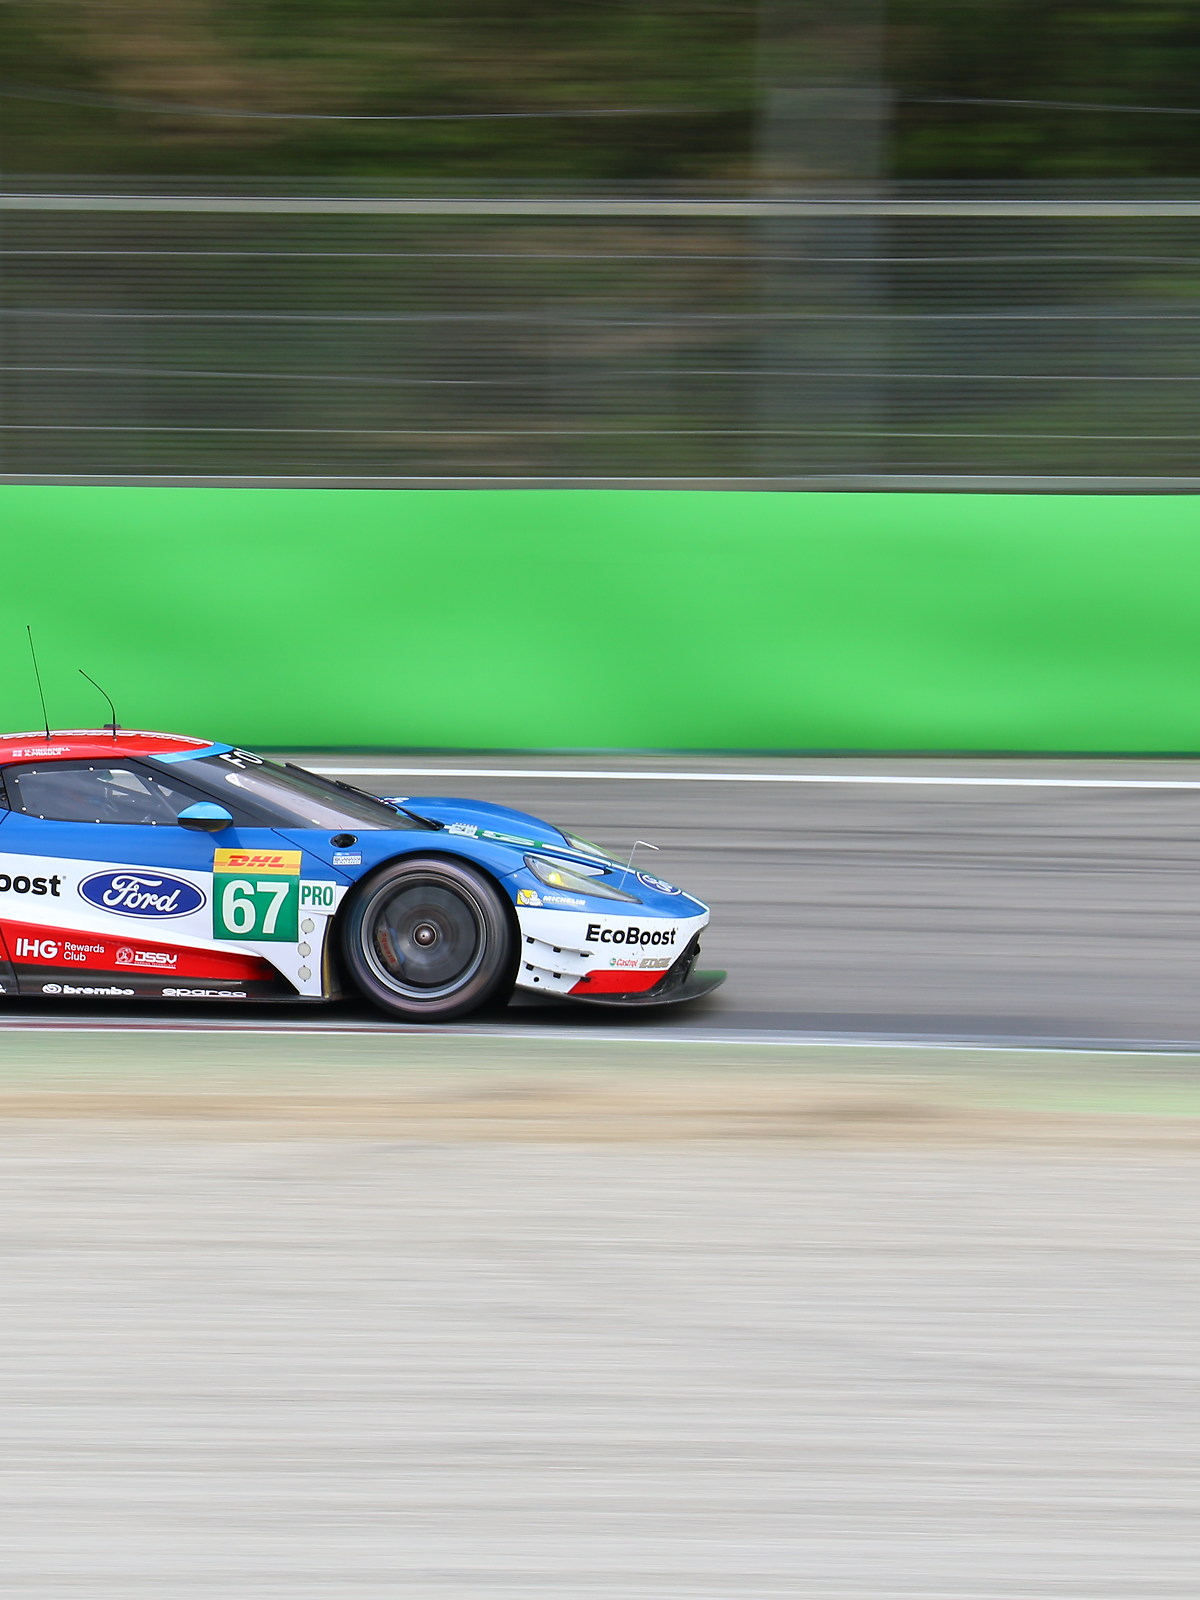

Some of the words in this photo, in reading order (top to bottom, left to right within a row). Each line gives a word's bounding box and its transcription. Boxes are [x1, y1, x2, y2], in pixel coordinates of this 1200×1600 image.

[228, 855, 287, 868] DHL
[103, 874, 181, 914] Ford
[301, 886, 334, 906] PRO
[542, 895, 586, 906] MICHELIN
[222, 879, 290, 935] 67
[585, 923, 676, 946] EcoBoost
[16, 938, 58, 959] IHG
[64, 942, 105, 954] Rewards
[63, 951, 87, 962] Club
[134, 950, 178, 964] DSSV
[616, 958, 639, 968] Castrol
[63, 984, 135, 996] brembo
